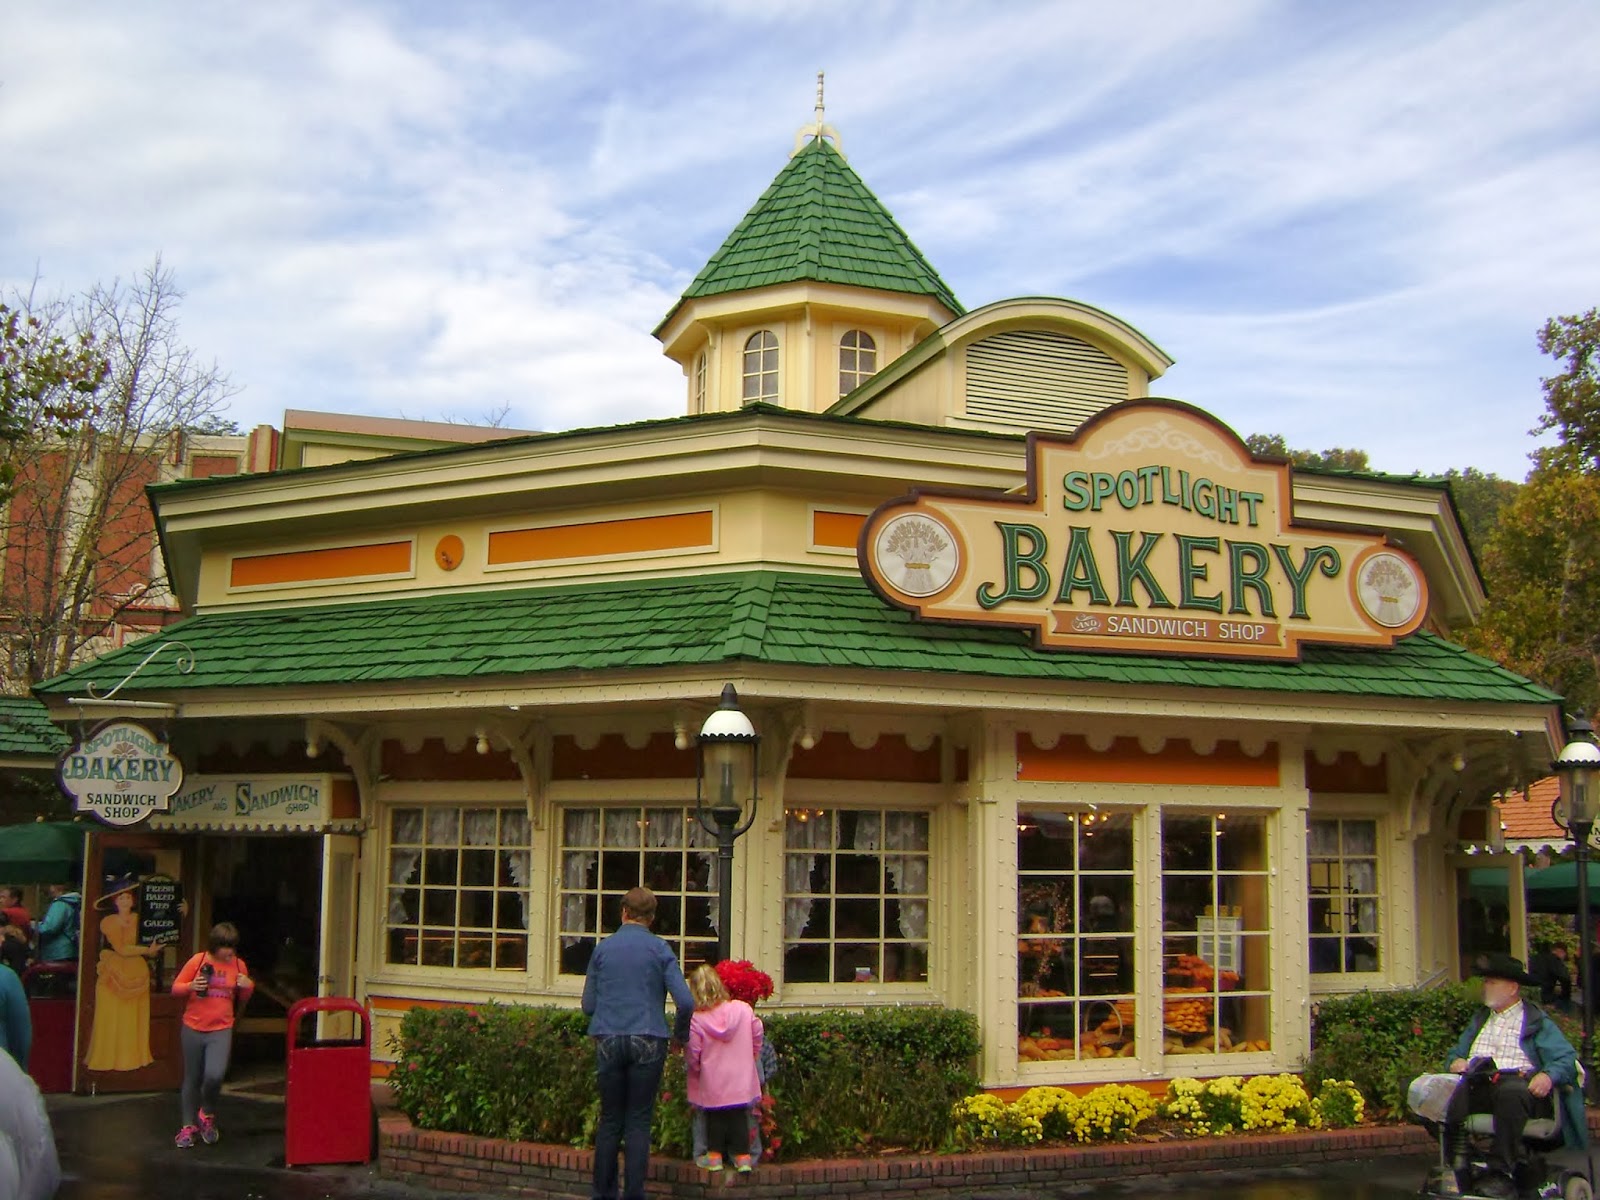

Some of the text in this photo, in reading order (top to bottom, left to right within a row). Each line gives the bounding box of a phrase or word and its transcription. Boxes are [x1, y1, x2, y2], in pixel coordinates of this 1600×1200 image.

[1063, 465, 1264, 527] SPOTLIGHT
[976, 521, 1341, 620] BAKERY
[1071, 614, 1265, 640] AND SANDWICH SHOP
[84, 727, 164, 758] SPOTLIGHT
[62, 755, 175, 782] BAKERY
[86, 793, 157, 806] SANDWICH
[104, 806, 140, 818] SHOP
[235, 782, 319, 816] SANDWICH
[285, 802, 310, 815] SHOP
[145, 893, 176, 901] BAKED
[150, 901, 170, 909] PIES
